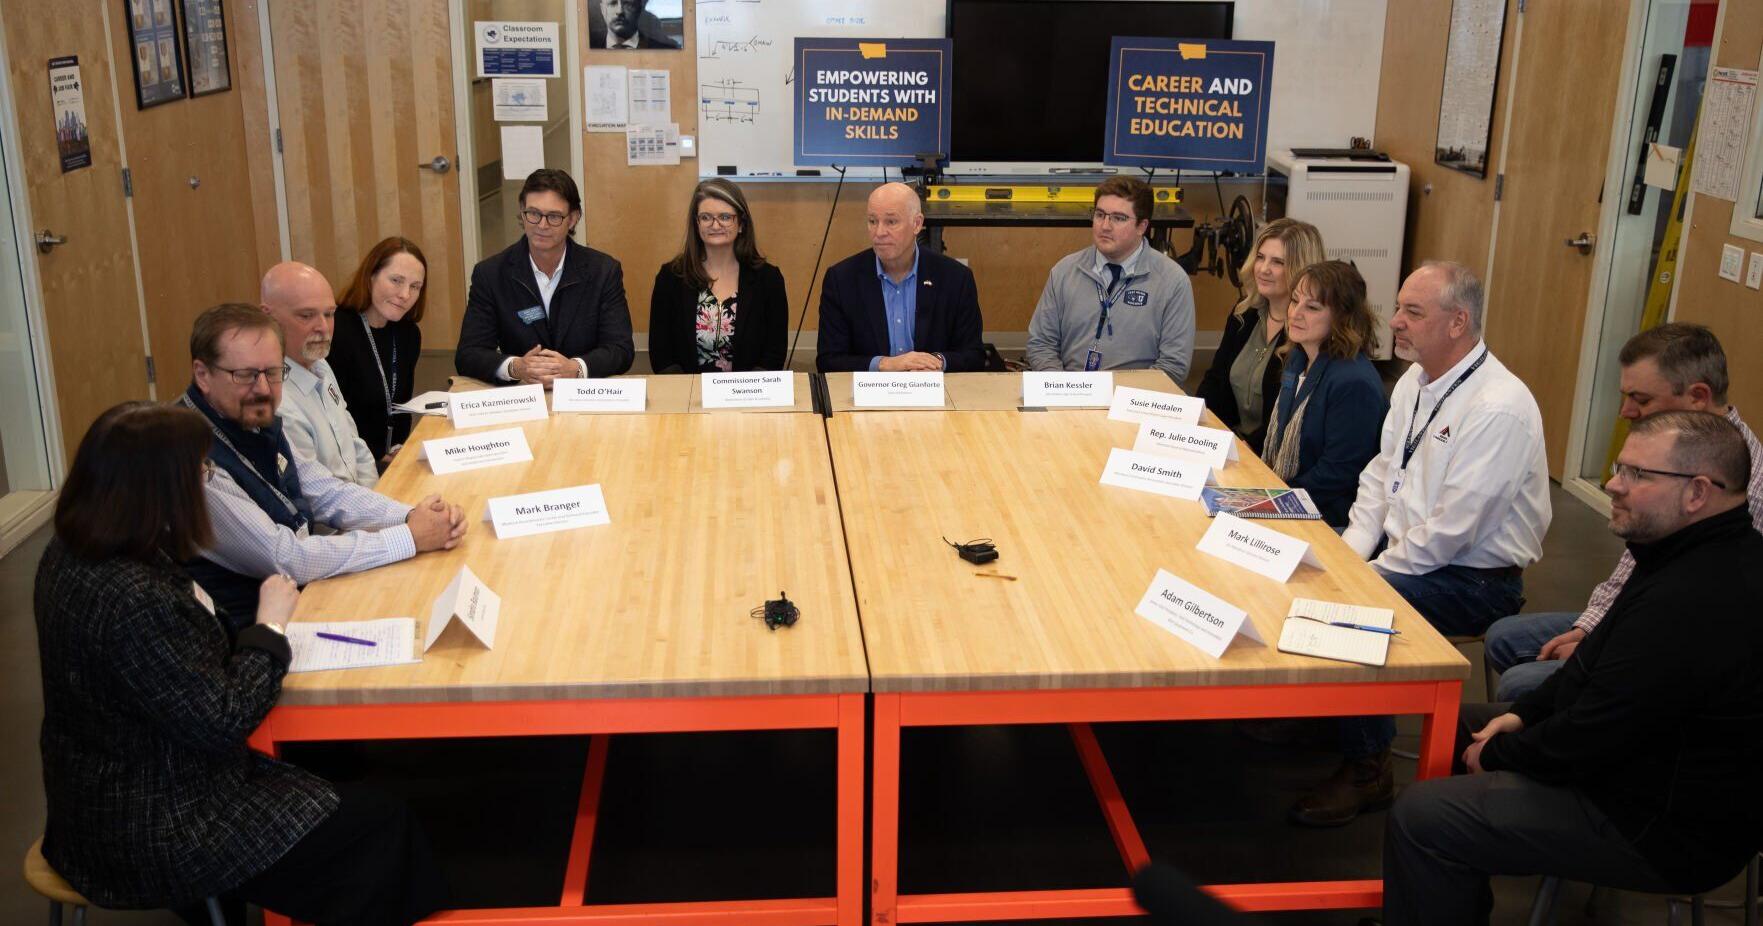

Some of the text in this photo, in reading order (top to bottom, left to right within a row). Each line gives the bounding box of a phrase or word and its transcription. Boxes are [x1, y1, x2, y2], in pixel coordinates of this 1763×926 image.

[503, 24, 543, 33] Classroom
[816, 70, 929, 86] EMPOWERING
[1128, 75, 1252, 95] CAREER AND
[808, 89, 936, 105] STUDENTS WITH
[825, 107, 919, 122] IN-DEMAND
[1134, 97, 1242, 117] TECHNICAL
[845, 125, 899, 140] SKILLS
[1131, 119, 1243, 139] EDUCATION
[712, 377, 761, 385] Commissioner
[891, 381, 907, 389] Greg
[1044, 380, 1093, 389] Brian Kessler
[576, 387, 623, 396] Todd O'Hair
[731, 387, 763, 395] Swanson
[460, 395, 537, 410] Erica Kazmierowski
[1130, 398, 1150, 408] Susie
[1151, 401, 1183, 414] Hedalen
[1149, 428, 1166, 439] Rep.
[1168, 431, 1186, 444] Julie
[1187, 435, 1218, 450] Dooling
[444, 439, 511, 456] Mike Houghton
[1131, 462, 1182, 479] David Smith
[515, 500, 582, 516] Mark Branger
[1227, 528, 1250, 544] Mark
[1250, 537, 1281, 557] Lillirose
[1160, 588, 1184, 606] Adam
[1184, 601, 1225, 628] Gilbertson
